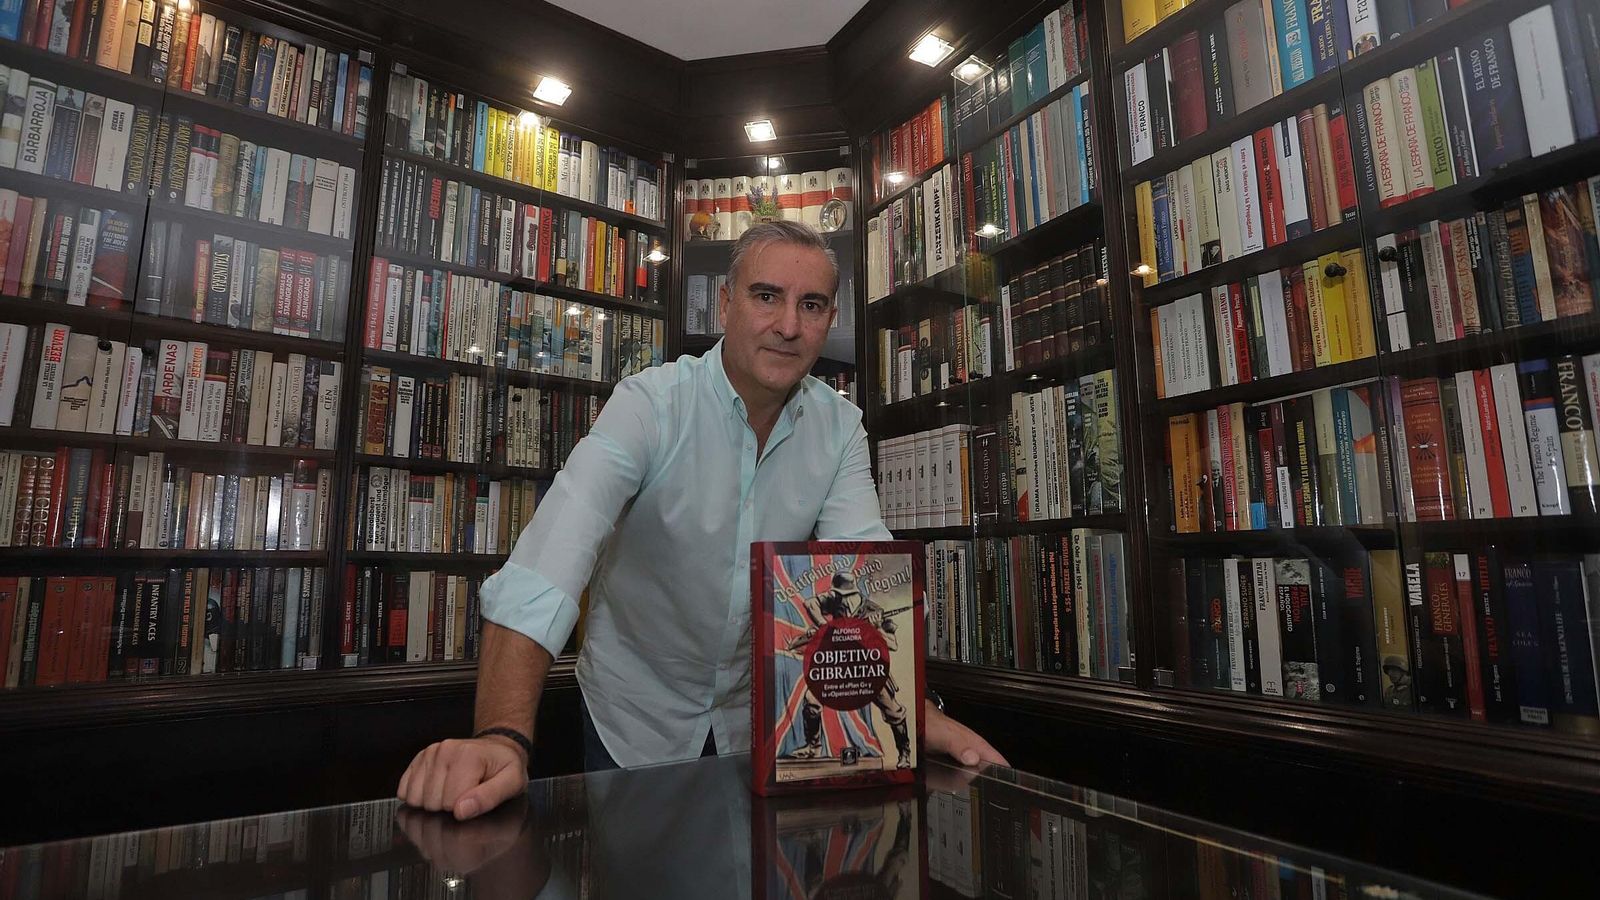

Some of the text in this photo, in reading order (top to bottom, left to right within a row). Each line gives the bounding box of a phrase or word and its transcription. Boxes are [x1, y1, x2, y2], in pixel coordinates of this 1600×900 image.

[1318, 34, 1327, 60] RICARDO
[1325, 39, 1332, 47] LA
[1326, 47, 1334, 56] DE
[1470, 49, 1485, 91] EL REINO
[1485, 38, 1502, 89] DE FRANCO
[1138, 100, 1147, 132] FRANCO
[1356, 103, 1368, 134] CAUDILLO
[1400, 88, 1413, 118] FRANCO
[24, 90, 48, 162] BARBARROJA
[1362, 136, 1370, 146] DEL
[1405, 119, 1416, 133] DE
[128, 113, 150, 182] ARMY GROUP CENTER
[170, 124, 191, 191] ARMY GROUP SOUTH
[1363, 147, 1372, 166] CARA
[1408, 133, 1422, 162] ESPAÑA
[1434, 136, 1448, 176] Franco
[562, 172, 567, 181] Mi
[1366, 167, 1374, 184] OTRA
[1414, 162, 1425, 176] LA
[428, 177, 442, 219] GOERING
[504, 217, 513, 251] KESSELRING
[933, 188, 943, 261] PANZERKAMPF
[1452, 223, 1468, 276] DIOSES NAZIS
[212, 252, 230, 293] STALINGRAD
[284, 274, 293, 315] STALINGRADO
[301, 277, 311, 318] STALINGRADO
[1285, 290, 1294, 318] FRANCO
[1462, 284, 1477, 325] EL OCASO
[1235, 311, 1244, 328] Raymond
[1306, 275, 1323, 357] Guerra, Dinero, Dictadura.
[50, 329, 65, 362] BEEVOR
[191, 347, 203, 378] BEEVOR
[162, 344, 178, 395] ARDENAS
[185, 391, 193, 411] ARDENAS
[324, 389, 333, 410] CIEN
[1557, 361, 1582, 429] FRANCO
[1296, 420, 1305, 443] MUNDIAL
[1263, 451, 1272, 474] STOPPED
[1298, 444, 1308, 466] GUERRA
[1528, 415, 1545, 486] The Franco Regime
[982, 450, 991, 504] La Gestapo
[1001, 472, 1010, 505] gestapo
[1302, 482, 1312, 503] ESPAÑA
[66, 496, 82, 539] Ostfront
[380, 474, 389, 525] Fallschirmjäger
[367, 497, 376, 544] Generaloberst
[1255, 561, 1266, 611] FRANCO MILITAR
[1406, 563, 1423, 606] VARELA
[1504, 568, 1531, 579] FRANCO
[131, 583, 143, 646] PANZERGRENADIER ACES
[147, 584, 160, 642] INFANTRY ACES
[180, 571, 192, 648] ON THE FIELD OF HONOR
[1241, 598, 1250, 629] SERRANO
[1284, 594, 1294, 632] HOLOCAUSTO
[1291, 585, 1302, 624] PRESTON
[1300, 585, 1309, 607] PAUL
[1431, 594, 1443, 631] FRANCO
[1439, 582, 1453, 632] GENERALES
[24, 602, 40, 661] Ritterkreuzträger
[809, 665, 886, 681] GIBRALTAR
[813, 649, 881, 665] OBJETIVO
